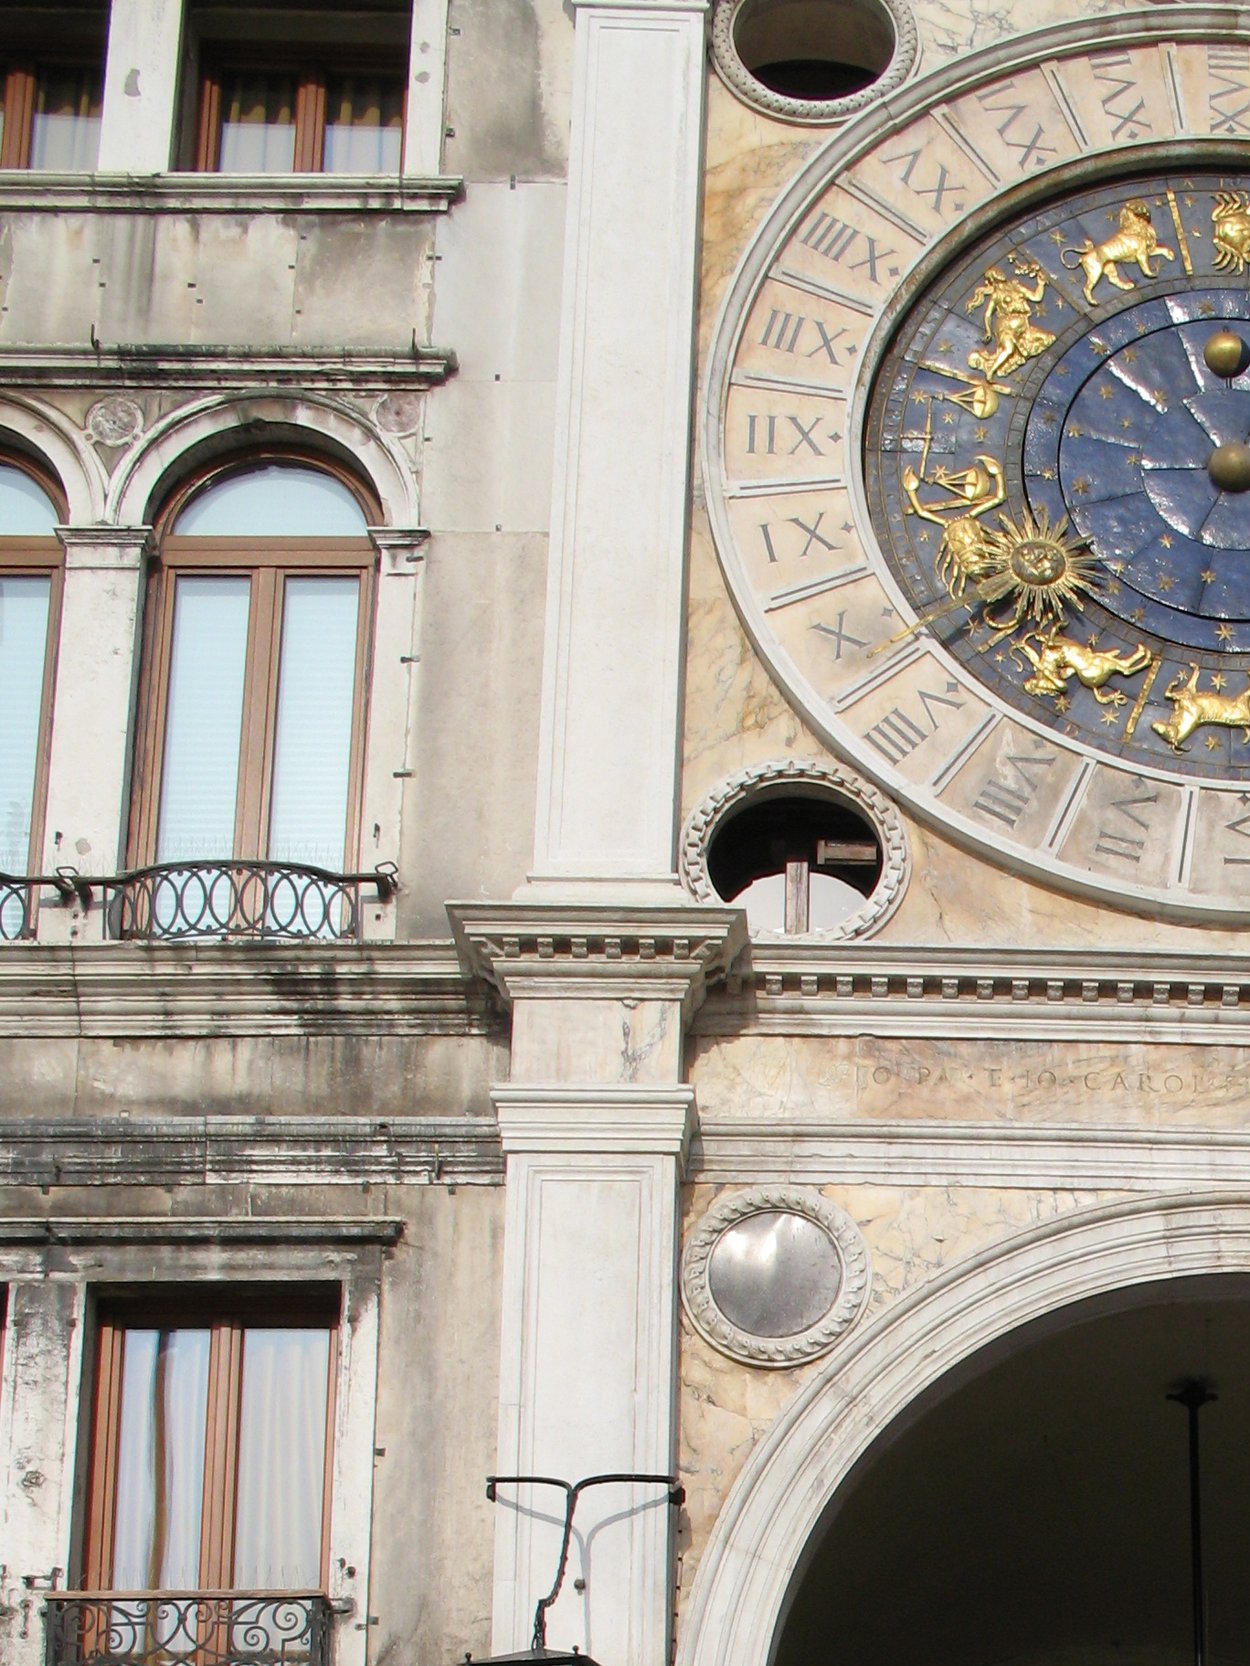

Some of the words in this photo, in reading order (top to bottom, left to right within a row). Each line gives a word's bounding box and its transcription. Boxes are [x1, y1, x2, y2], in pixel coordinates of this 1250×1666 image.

[974, 80, 1057, 171] XVI
[879, 148, 968, 214] XV
[801, 211, 898, 285] XIIII
[759, 310, 848, 366] XIII
[746, 414, 825, 456] XII
[759, 512, 844, 563] XI
[808, 610, 871, 662] X
[863, 690, 966, 765] VIIII
[973, 757, 1057, 829] VIII
[1096, 792, 1160, 863] VII
